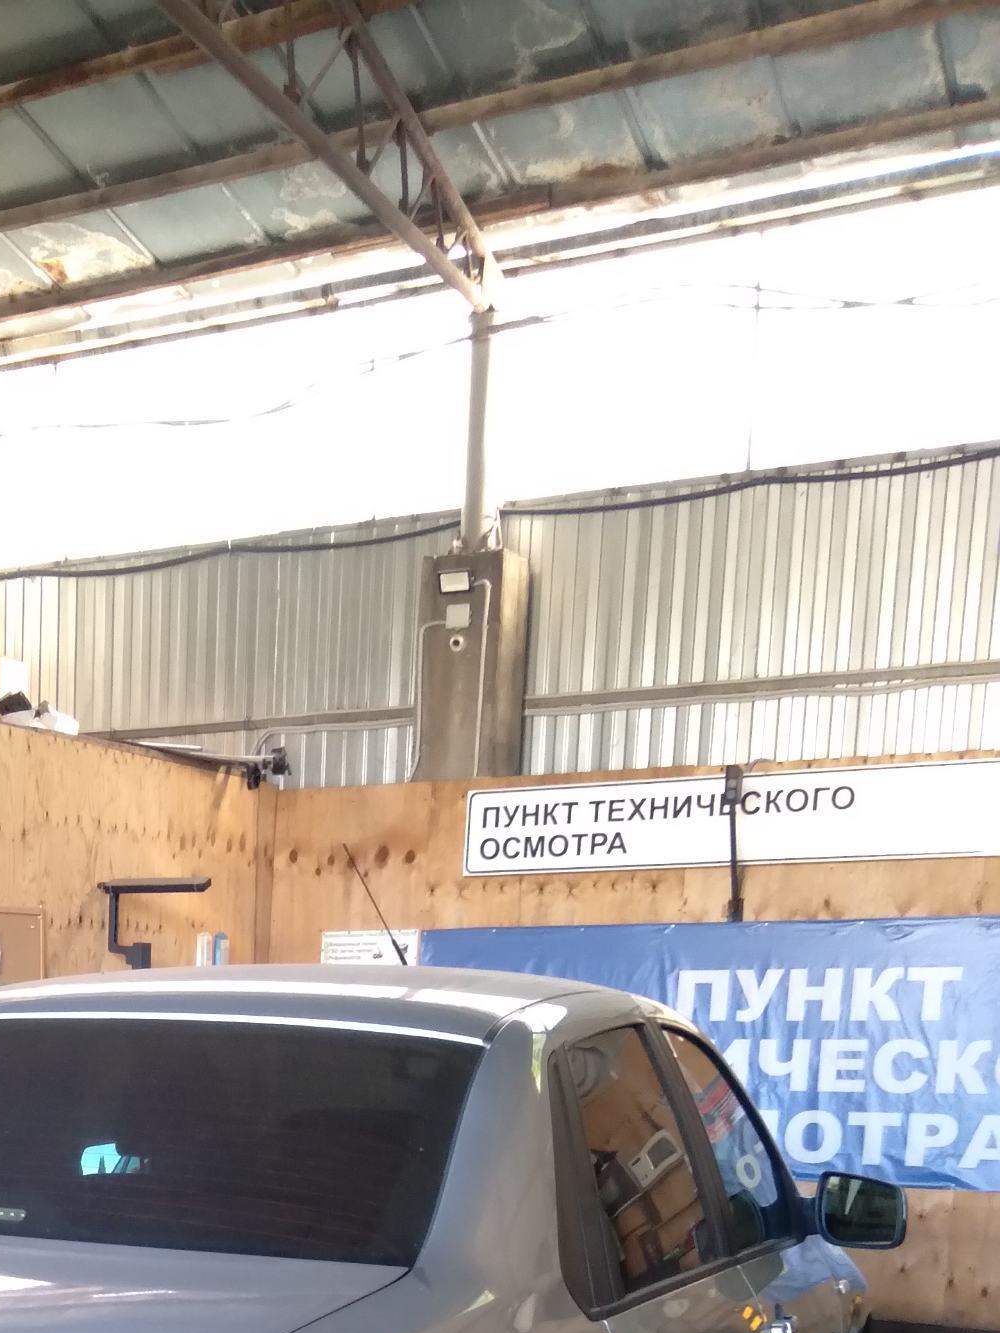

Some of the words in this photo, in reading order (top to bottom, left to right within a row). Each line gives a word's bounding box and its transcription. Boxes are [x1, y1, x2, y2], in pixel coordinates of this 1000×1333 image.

[481, 801, 583, 829] ПУНКТ
[479, 831, 628, 860] ОСМОТРА
[675, 966, 963, 1022] ПУНКТ
